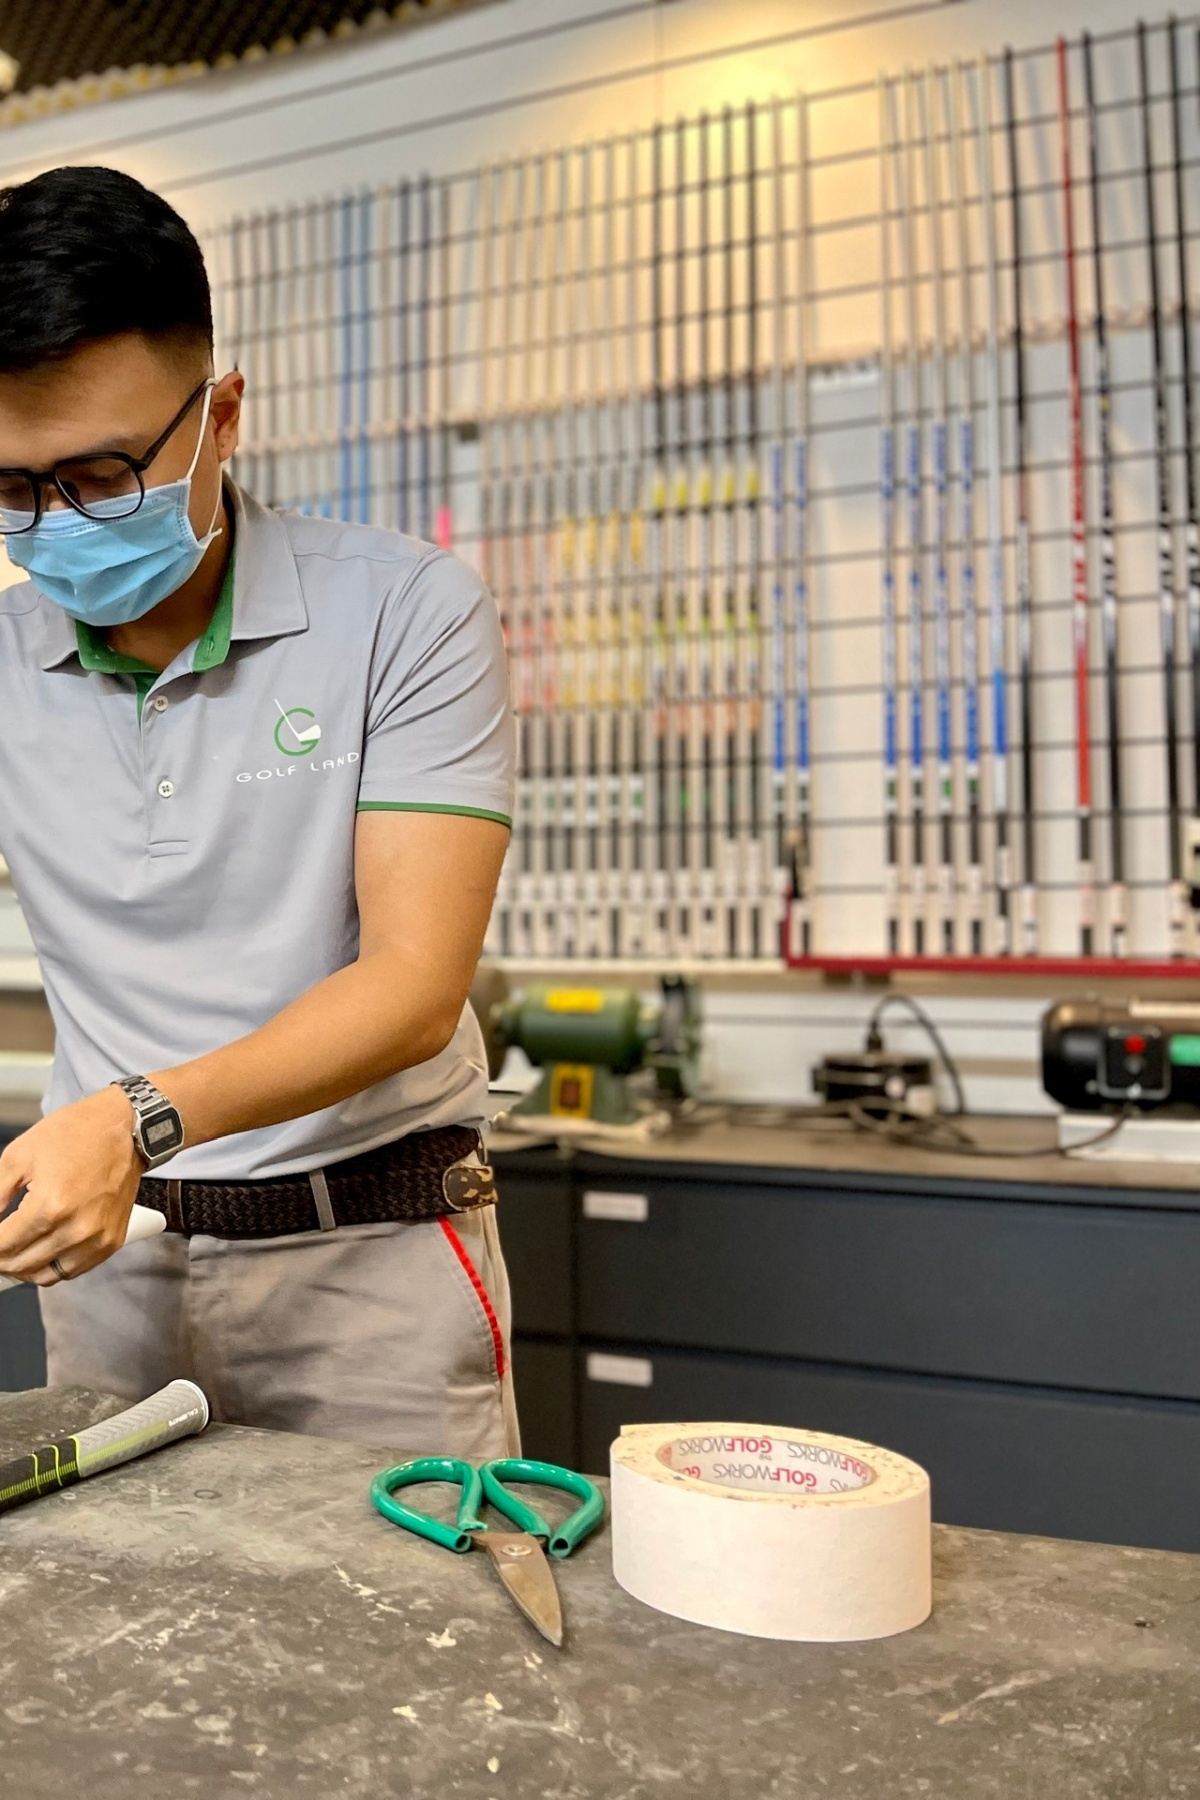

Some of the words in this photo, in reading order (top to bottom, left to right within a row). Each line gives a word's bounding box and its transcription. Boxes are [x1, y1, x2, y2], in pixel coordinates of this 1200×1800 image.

[235, 765, 296, 783] GOLF
[310, 752, 360, 771] LAND
[679, 1438, 772, 1456] GOLFWORKS
[712, 1463, 817, 1487] GOLFWORKS
